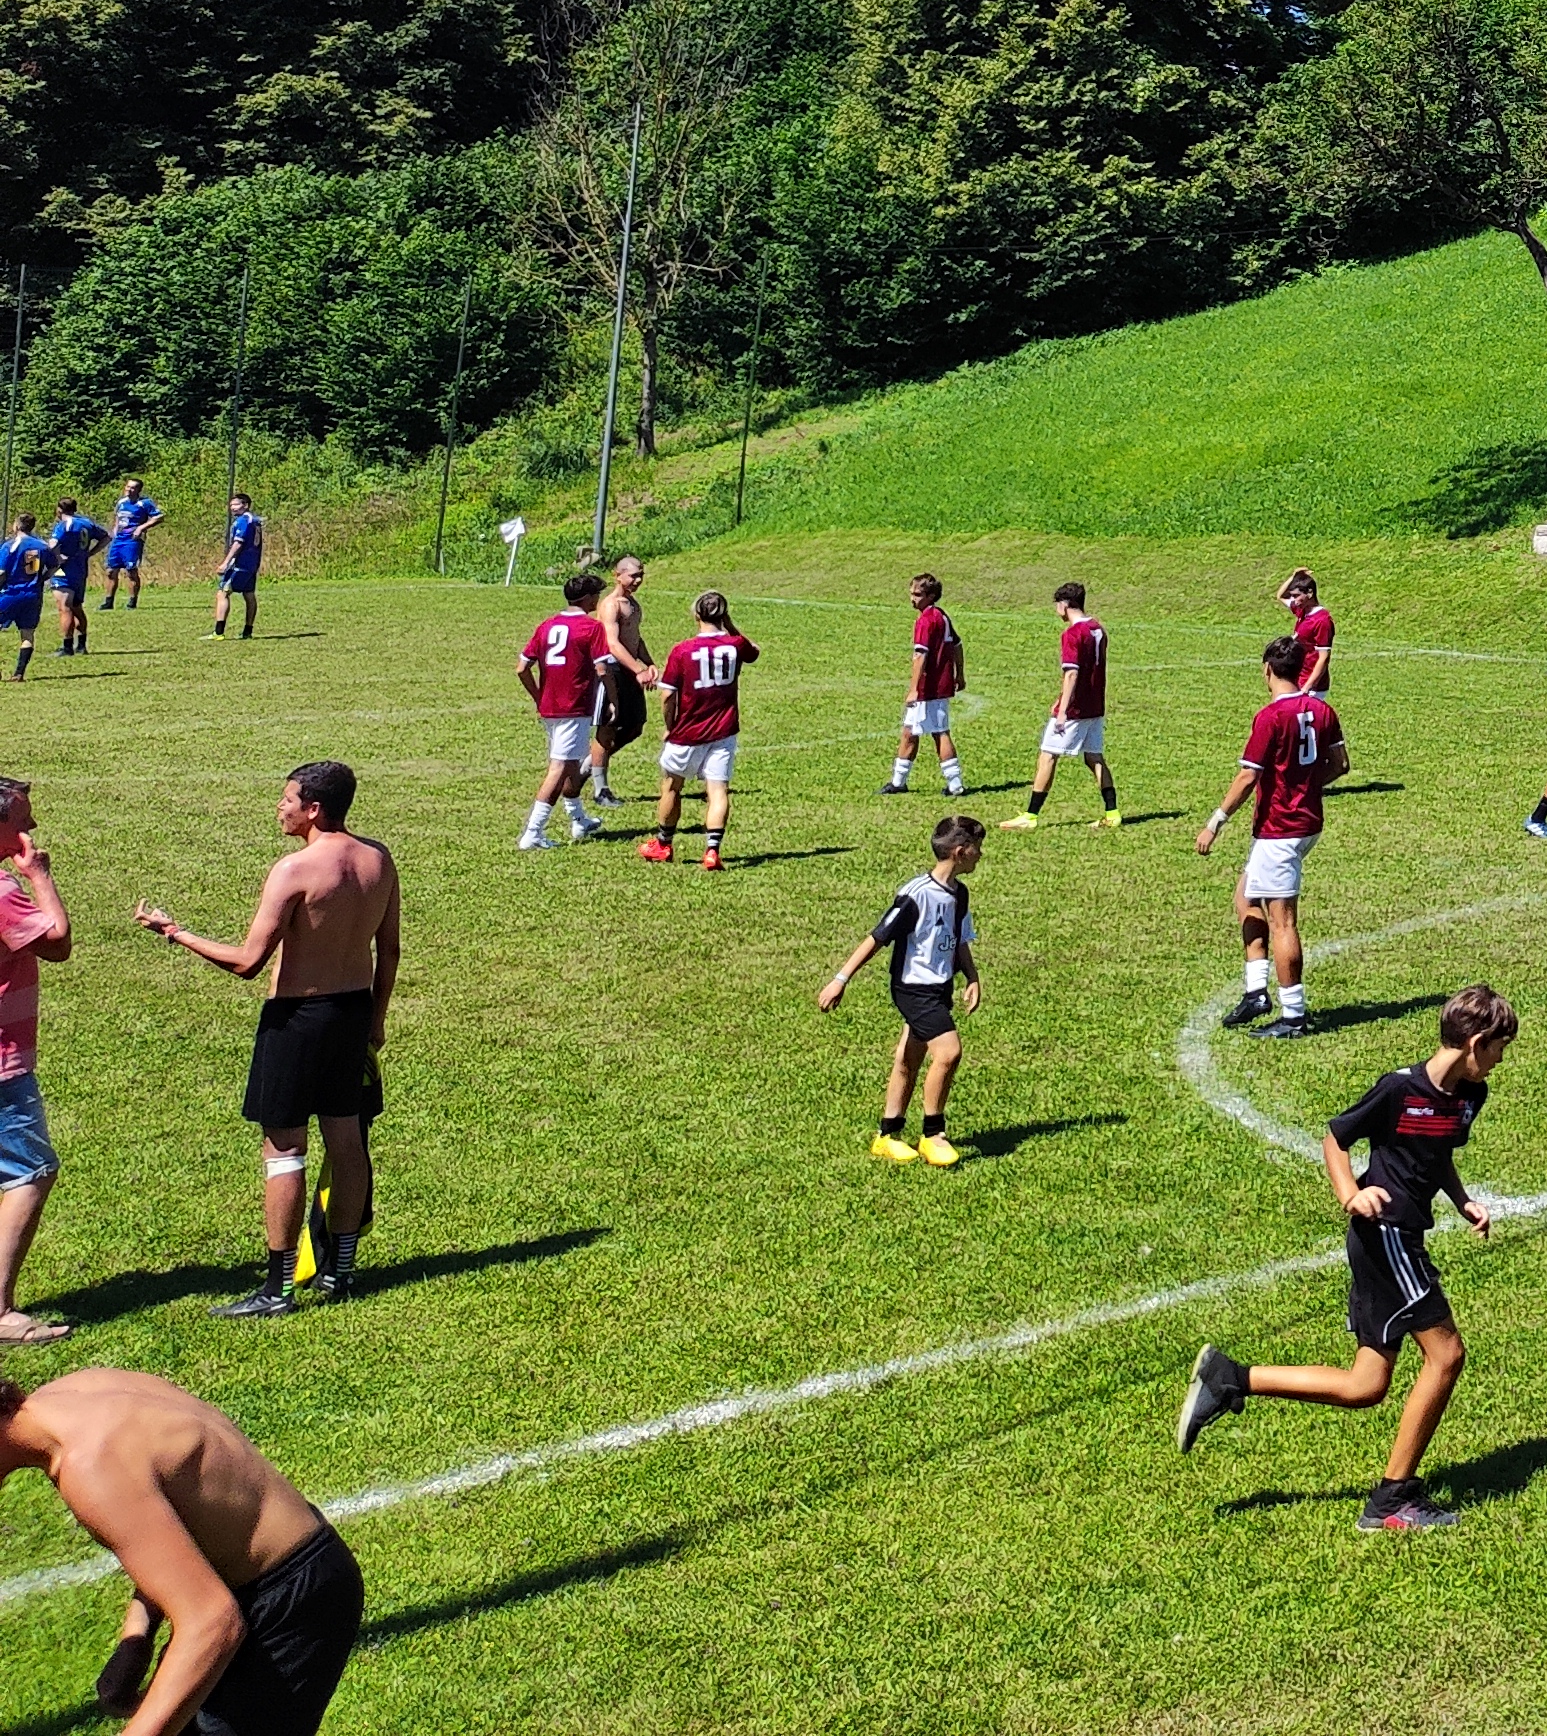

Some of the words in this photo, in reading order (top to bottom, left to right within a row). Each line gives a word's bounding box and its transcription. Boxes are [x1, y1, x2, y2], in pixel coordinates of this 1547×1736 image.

[546, 624, 569, 665] 2
[691, 645, 737, 689] 10
[1297, 711, 1317, 766] 5
